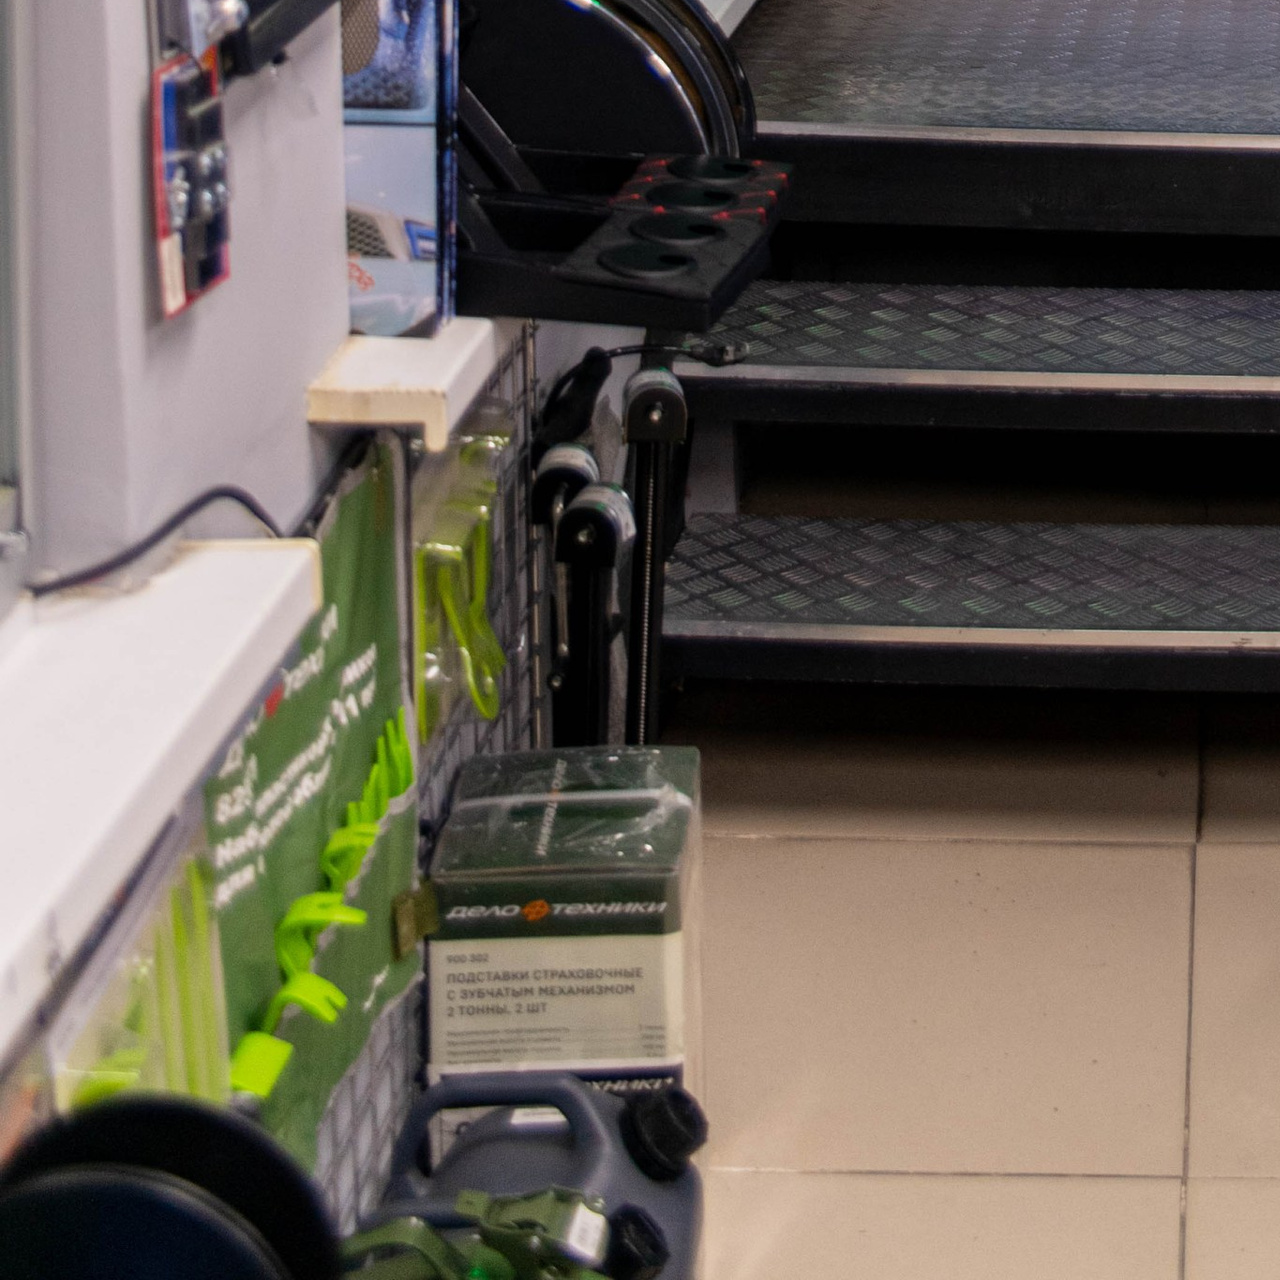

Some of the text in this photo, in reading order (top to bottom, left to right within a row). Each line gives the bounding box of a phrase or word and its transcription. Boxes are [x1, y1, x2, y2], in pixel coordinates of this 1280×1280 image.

[446, 967, 643, 985] ПОДСТАВКИ СТРАХОВОЧНЫЕ
[447, 984, 635, 1001] С ЗУБЧАТЫМ МЕХАНИЗМОМ
[447, 1006, 455, 1017] 2
[516, 1003, 523, 1014] 2
[526, 1002, 547, 1014] ШТ
